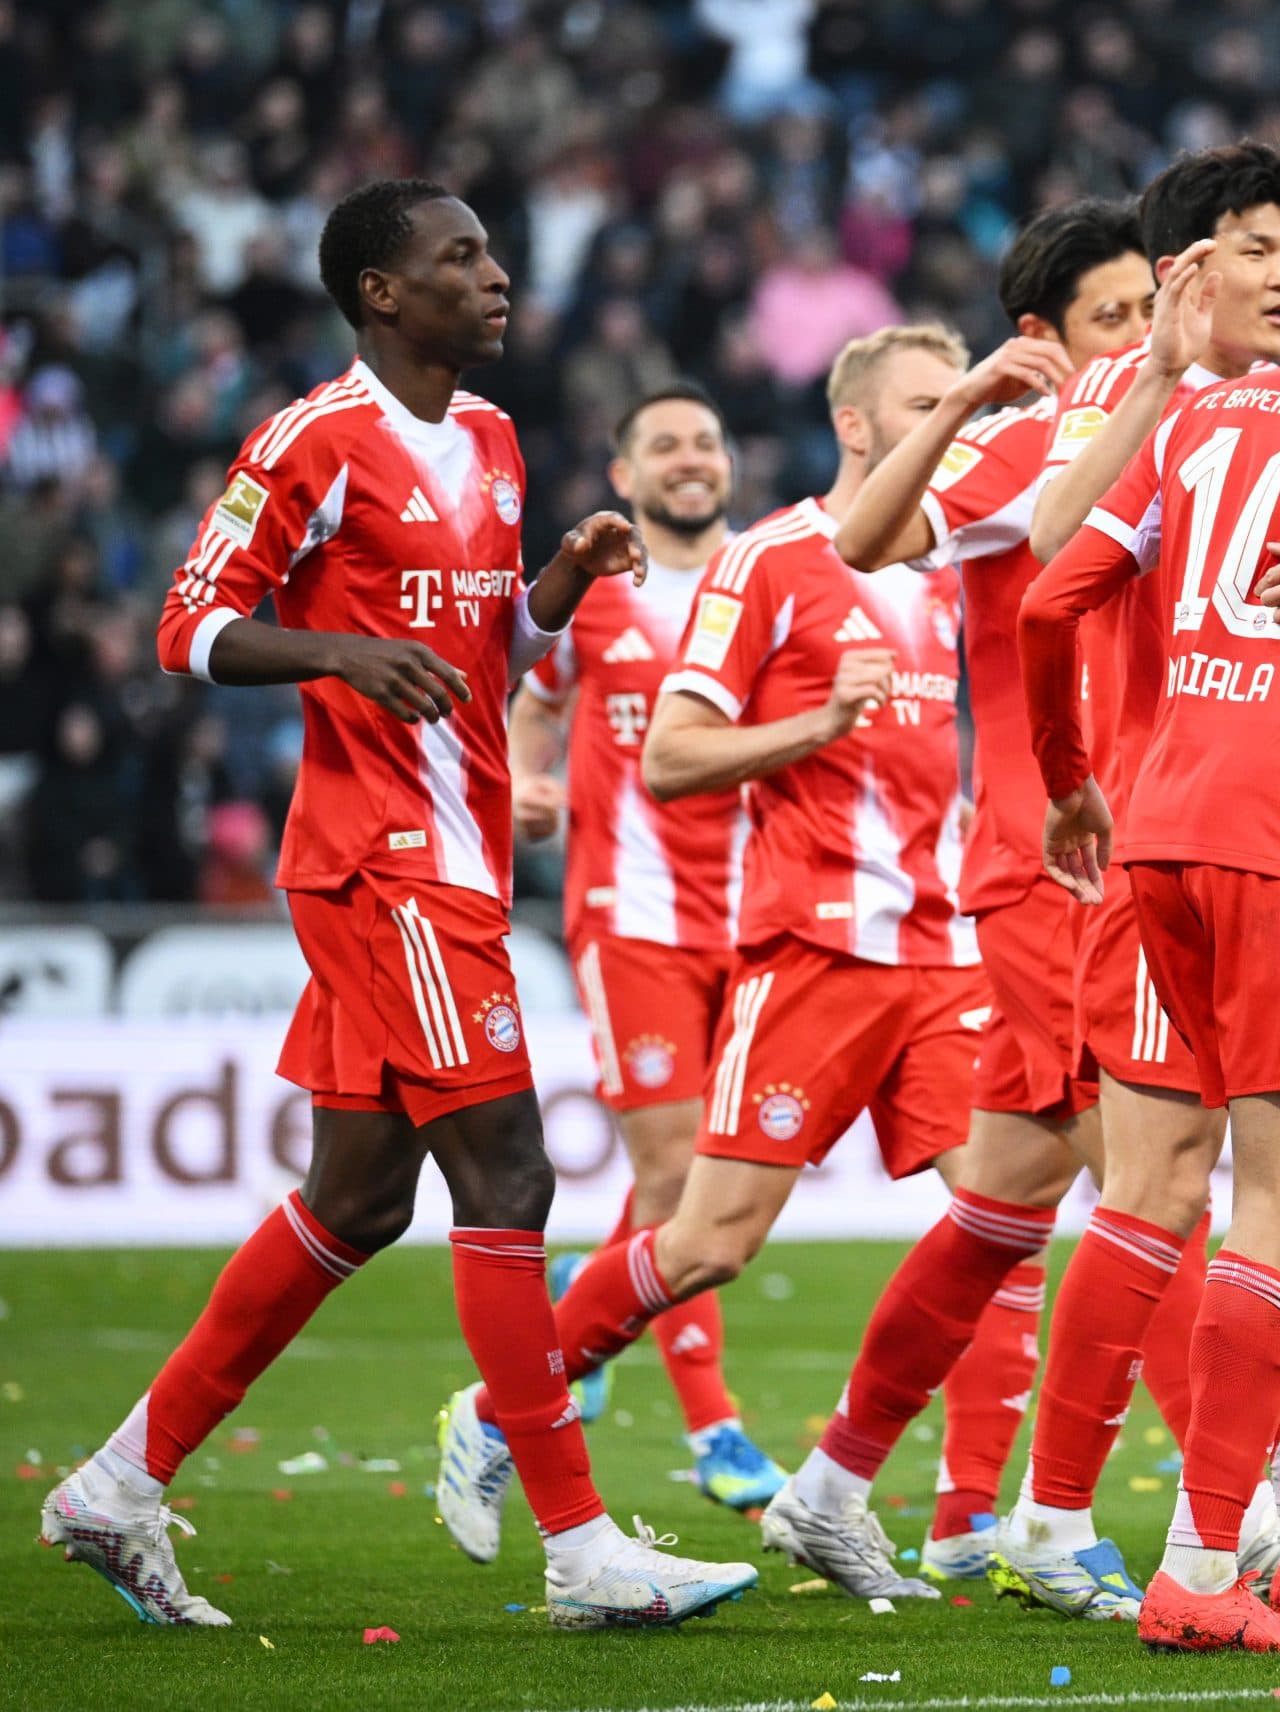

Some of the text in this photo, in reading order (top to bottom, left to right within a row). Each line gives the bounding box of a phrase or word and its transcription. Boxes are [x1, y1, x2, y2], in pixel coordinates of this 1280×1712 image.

[1194, 391, 1225, 410] FC
[400, 570, 443, 628] T
[455, 600, 480, 627] TV
[891, 699, 921, 726] TV
